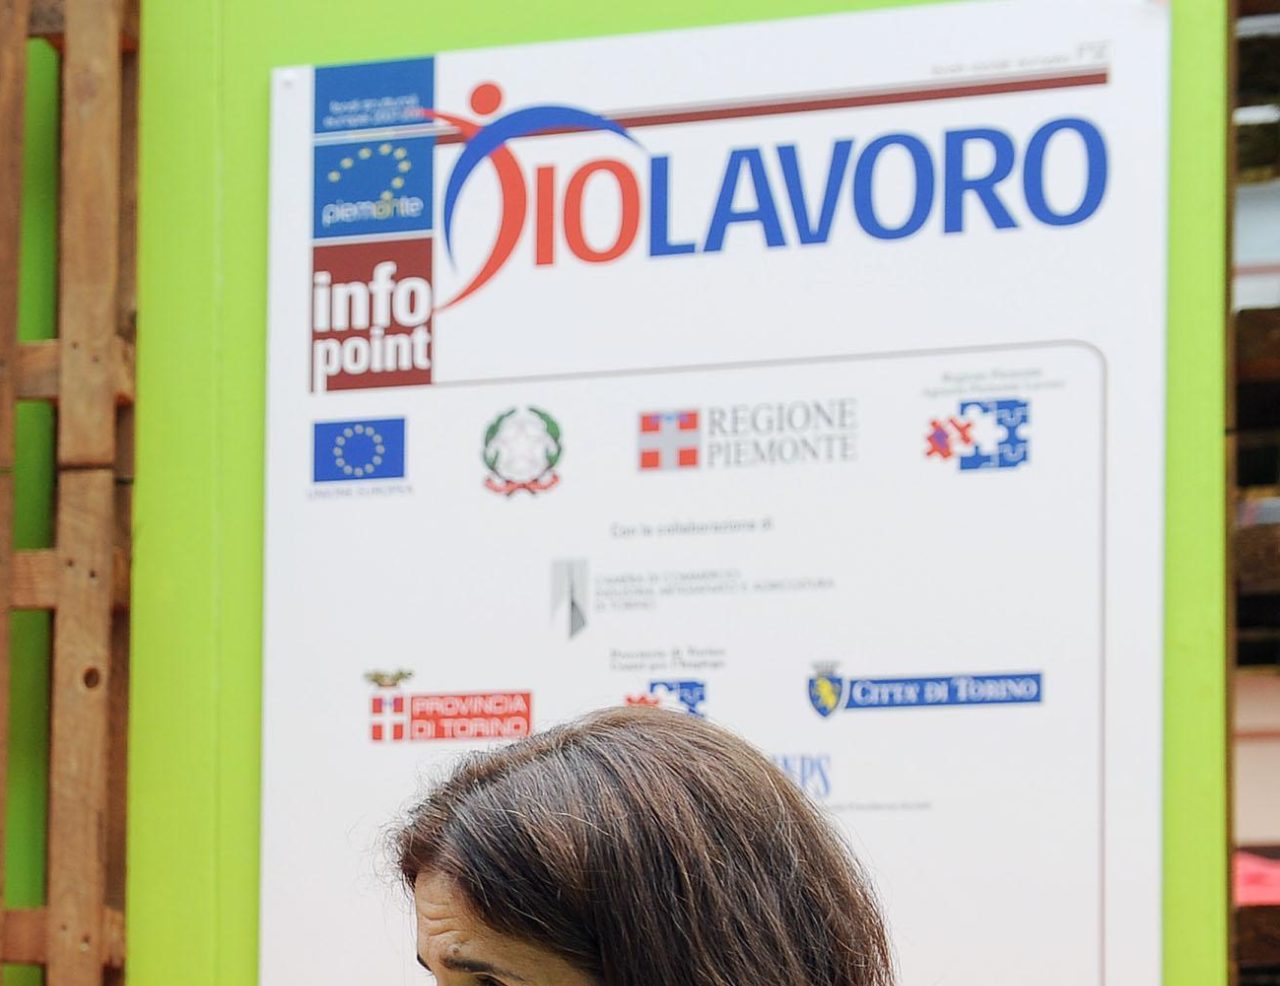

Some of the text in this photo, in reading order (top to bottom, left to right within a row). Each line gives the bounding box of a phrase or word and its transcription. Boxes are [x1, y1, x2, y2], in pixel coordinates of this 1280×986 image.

[534, 117, 1109, 266] IOLAVORO
[322, 196, 424, 227] piemonte
[313, 260, 432, 333] info
[313, 324, 432, 392] point
[708, 398, 858, 435] REGIONE
[707, 434, 858, 468] PIEMONTE
[412, 694, 528, 716] PROVINCIA
[412, 715, 529, 739] DI TORINO
